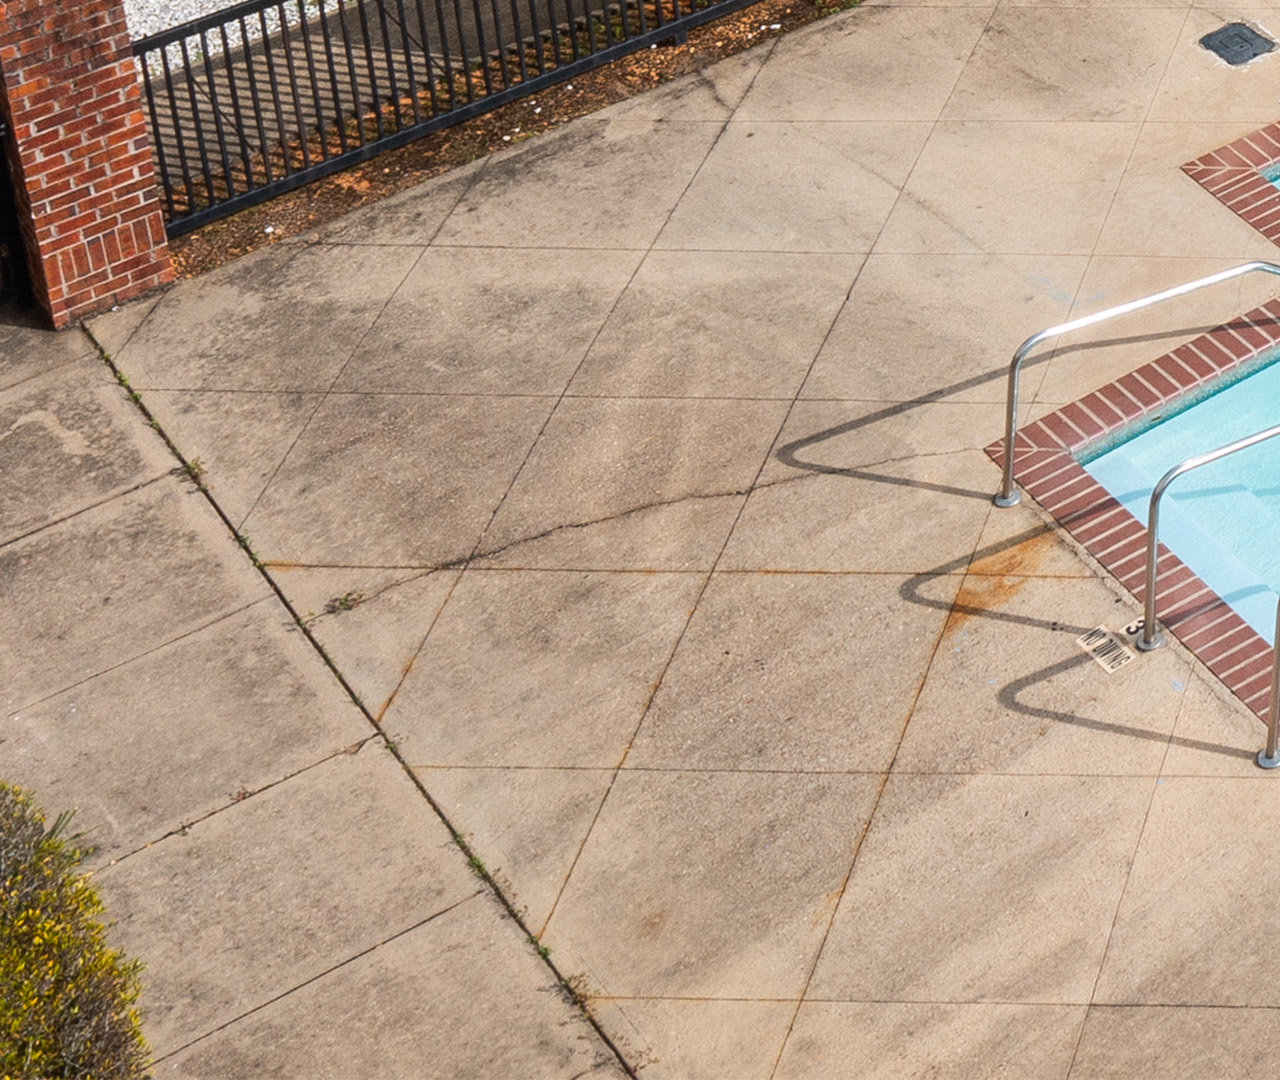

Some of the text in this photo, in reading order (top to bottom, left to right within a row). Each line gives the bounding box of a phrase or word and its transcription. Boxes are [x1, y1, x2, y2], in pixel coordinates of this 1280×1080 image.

[1126, 620, 1145, 636] 3
[1082, 627, 1131, 669] NO DIVING
